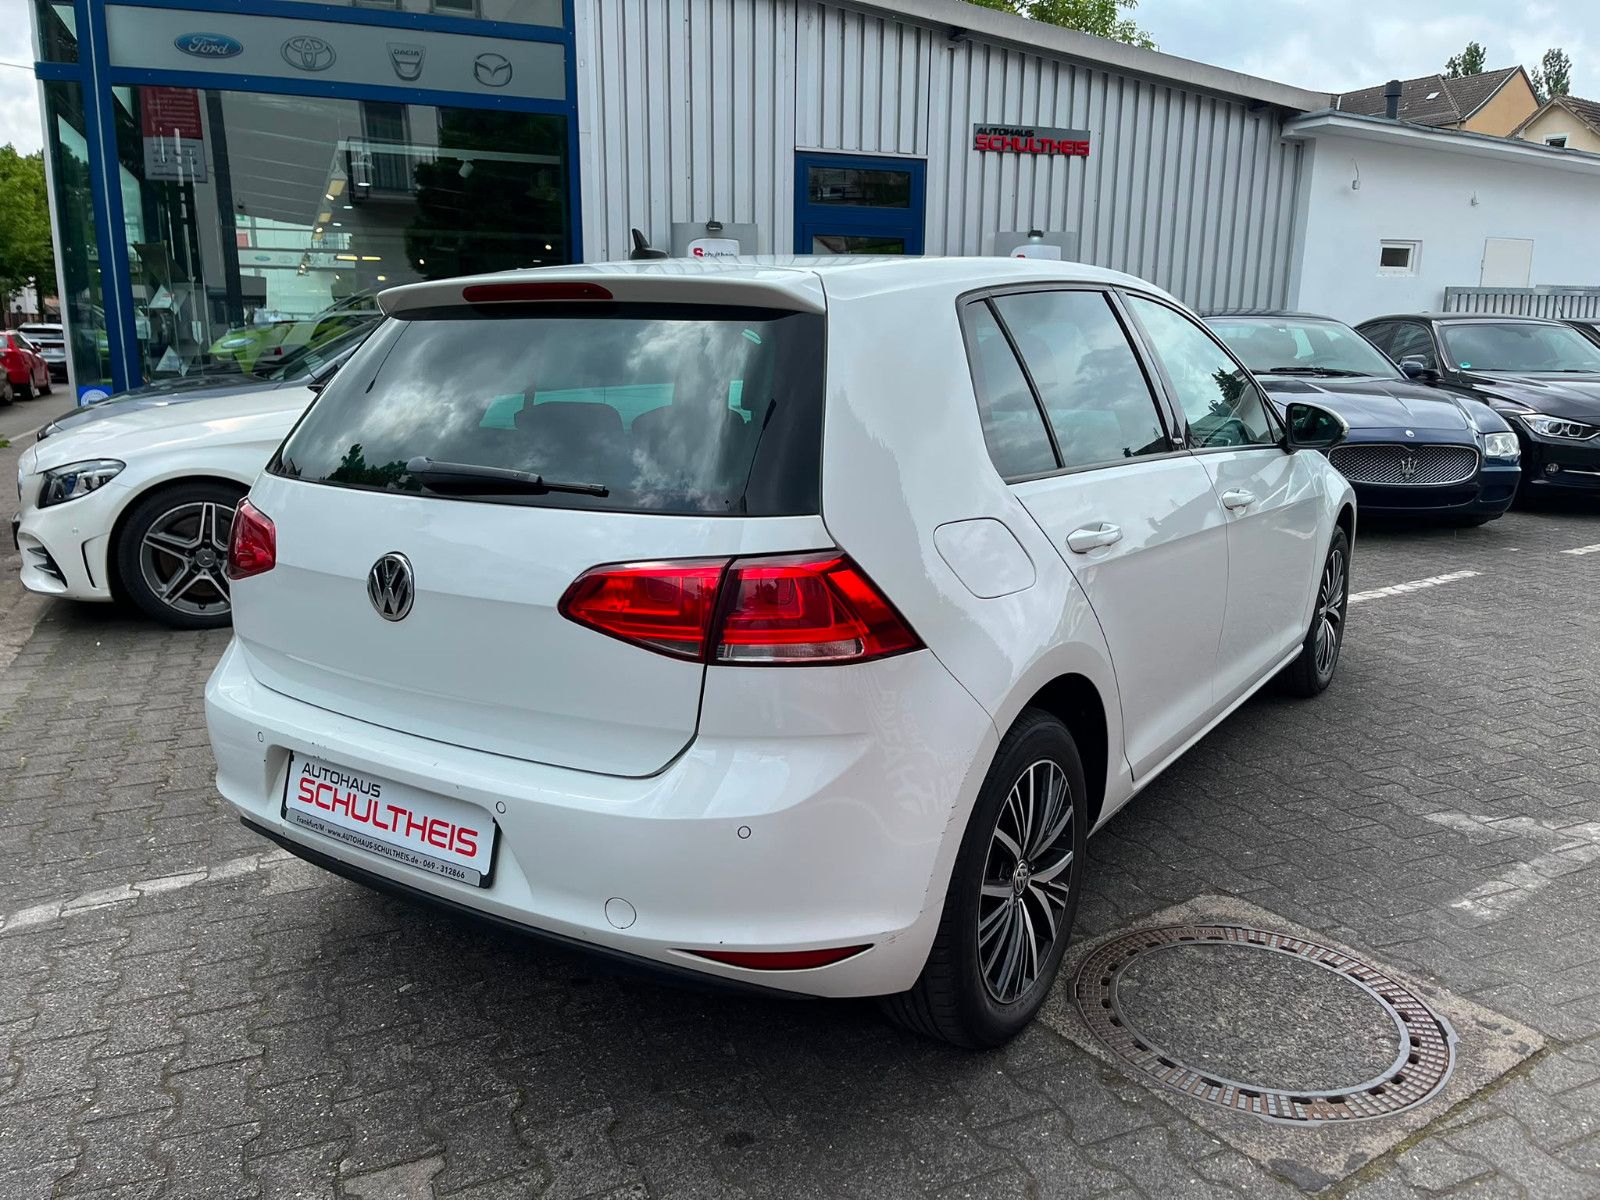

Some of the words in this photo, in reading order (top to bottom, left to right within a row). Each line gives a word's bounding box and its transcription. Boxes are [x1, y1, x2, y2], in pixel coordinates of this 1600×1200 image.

[188, 37, 230, 54] Ford
[977, 127, 1035, 137] AUTOHAUS
[975, 134, 1090, 156] SCHULTHEIS
[301, 762, 382, 798] AUTOHAUS
[298, 777, 478, 858] SCHULTHEIS
[423, 859, 436, 870] 069
[440, 865, 465, 879] 312866
